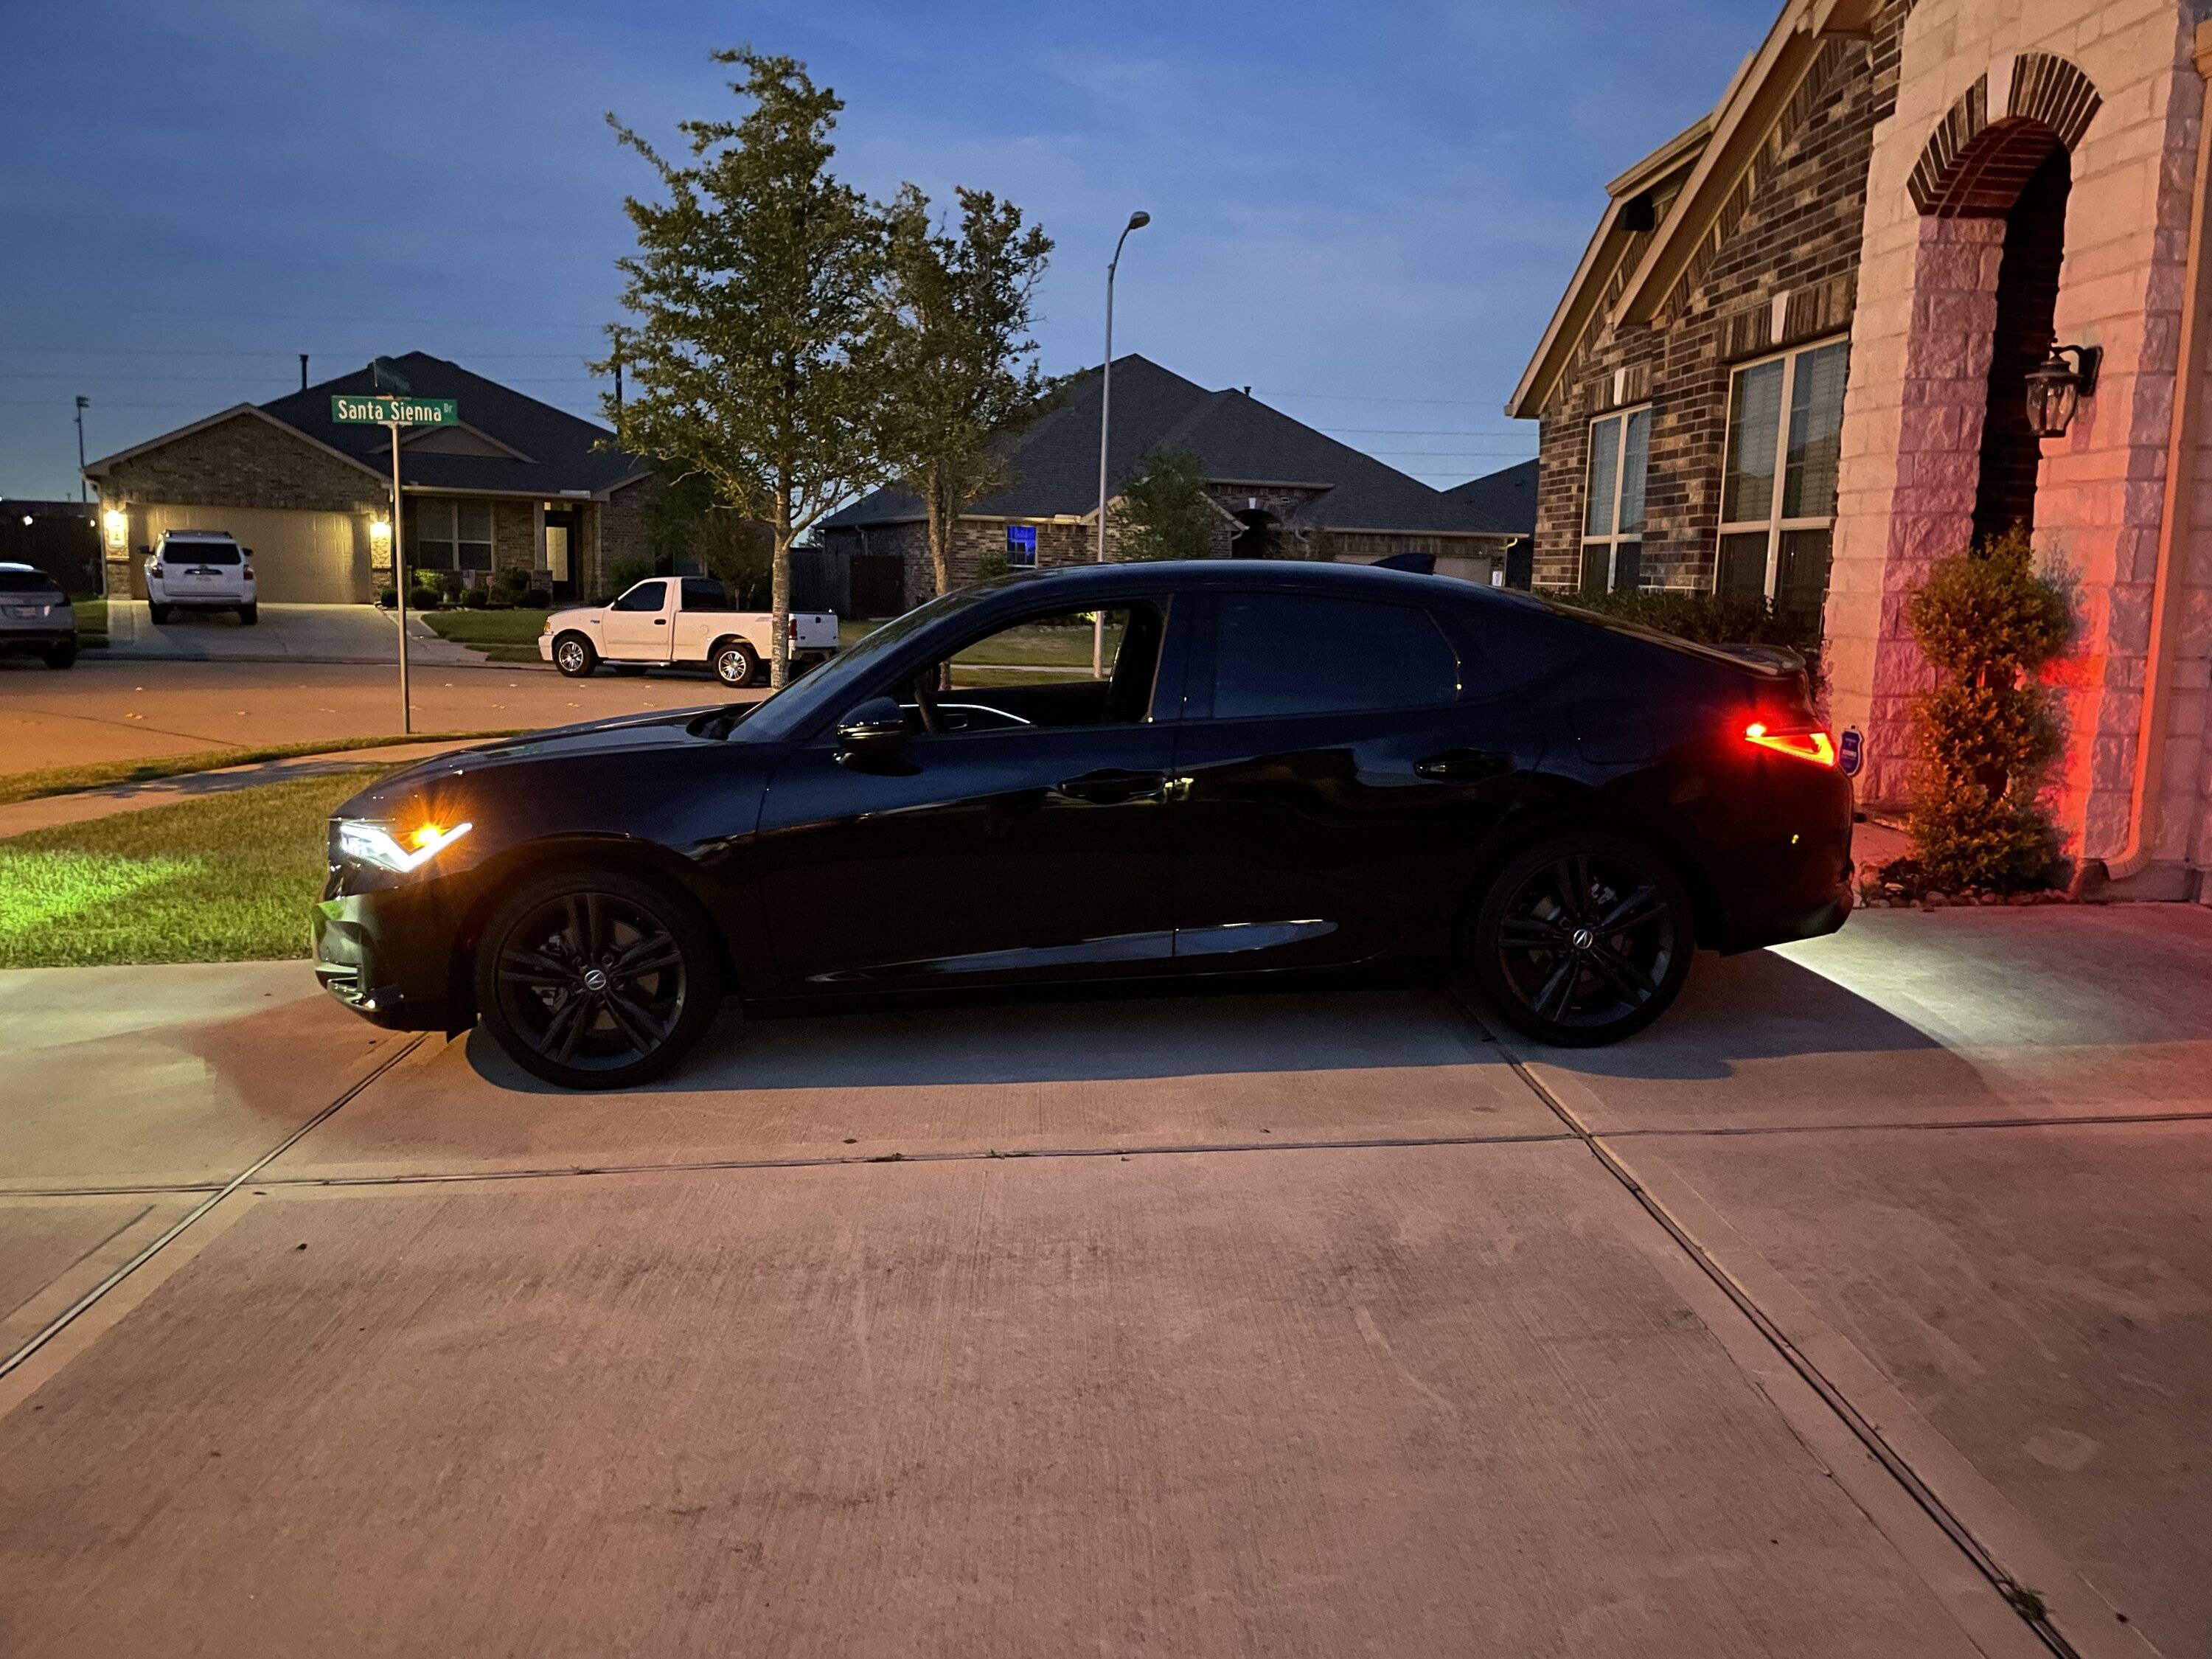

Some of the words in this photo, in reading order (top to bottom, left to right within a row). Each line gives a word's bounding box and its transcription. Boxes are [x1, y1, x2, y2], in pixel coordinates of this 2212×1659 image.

[338, 400, 383, 420] Santa
[391, 401, 442, 422] Sienna
[444, 403, 452, 413] Dr
